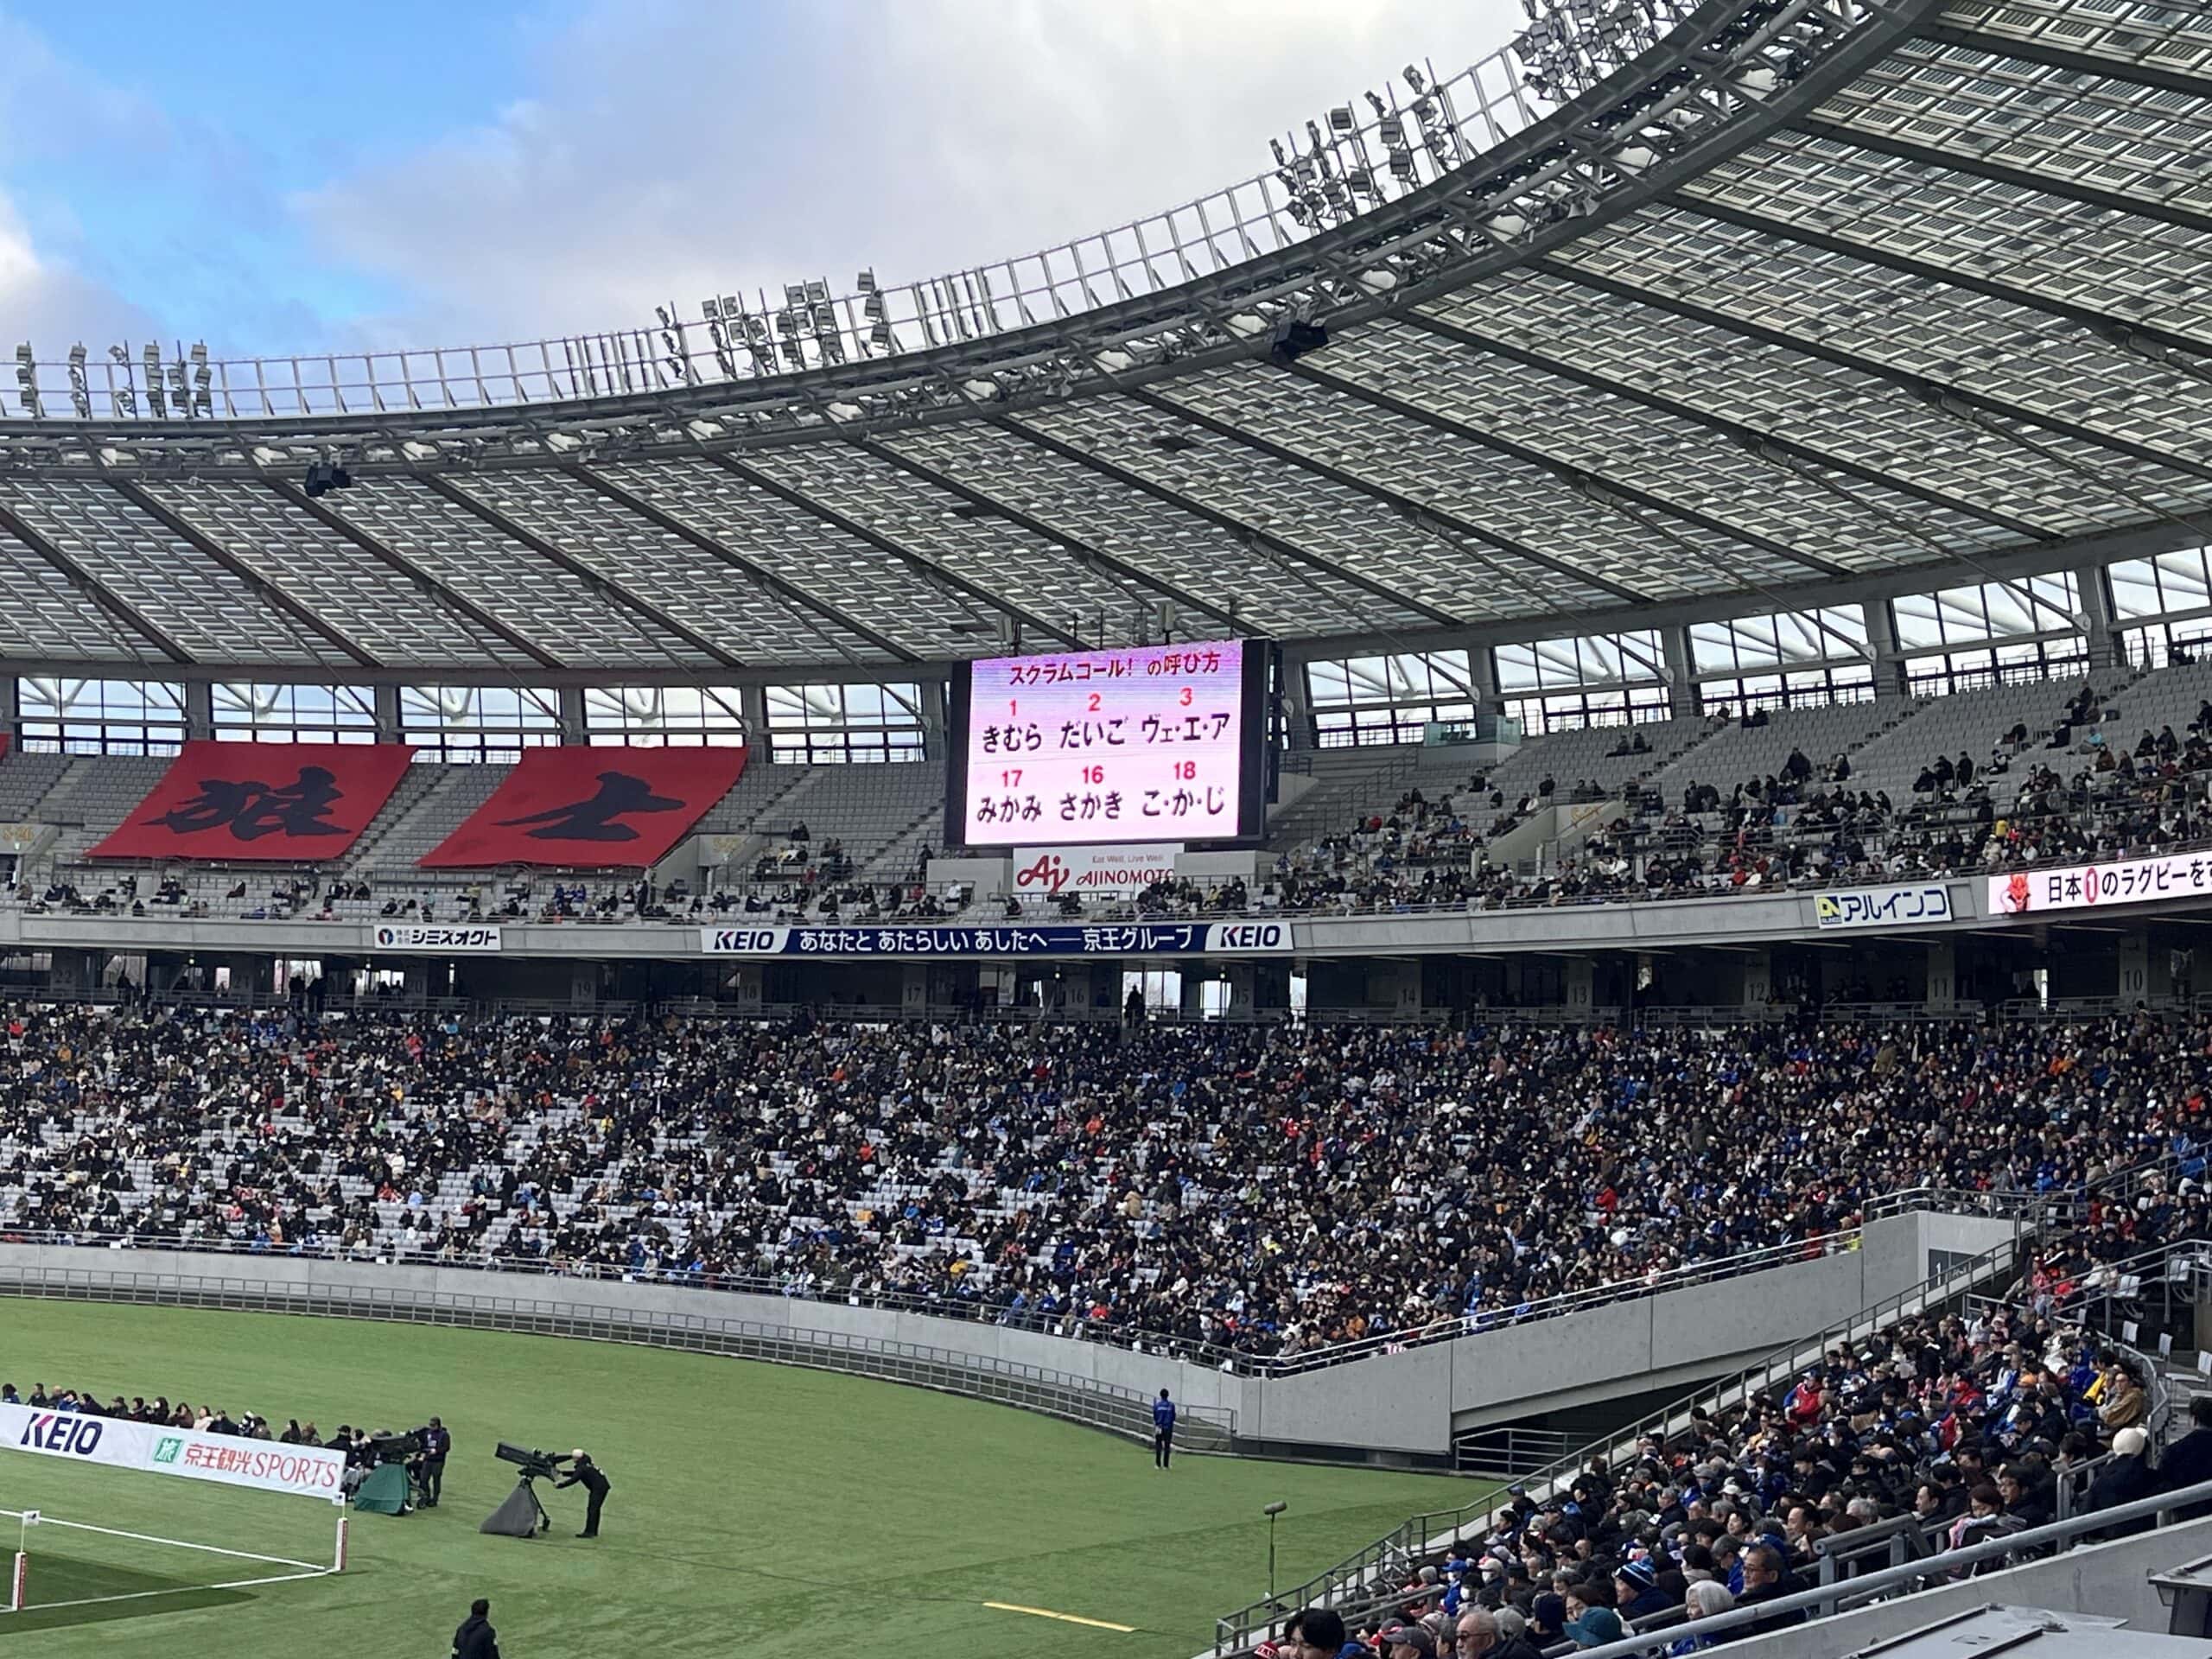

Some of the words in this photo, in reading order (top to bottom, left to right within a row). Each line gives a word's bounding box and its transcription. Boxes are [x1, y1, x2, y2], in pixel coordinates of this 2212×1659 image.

[1147, 651, 1222, 677] の呼び方
[1009, 698, 1018, 716] 1
[1088, 693, 1102, 712] 2
[1179, 687, 1193, 706] 3
[982, 723, 1042, 753] きむら
[1059, 716, 1129, 749] だいご
[1001, 769, 1023, 788] 17
[1081, 765, 1104, 785] 16
[1173, 760, 1197, 780] 18
[976, 794, 1043, 823] みかみ
[1059, 790, 1123, 822] さかき
[1076, 868, 1175, 887] AJINOMOTO
[1840, 889, 1947, 922] アルインコ
[714, 931, 775, 950] KEIO
[799, 930, 872, 951] あなたと
[878, 930, 969, 951] あたらしい
[1082, 925, 1192, 951] 京王グループ
[1220, 925, 1281, 948] KEIO
[577, 982, 592, 996] 19
[1933, 977, 1948, 998] 11
[2124, 968, 2144, 991] 10
[907, 987, 921, 1002] 17
[1071, 988, 1085, 1004] 16
[1235, 988, 1249, 1005] 15
[1402, 988, 1416, 1004] 14
[1573, 987, 1587, 1004] 13
[1749, 982, 1765, 1001] 12
[20, 1412, 103, 1455] KEIO
